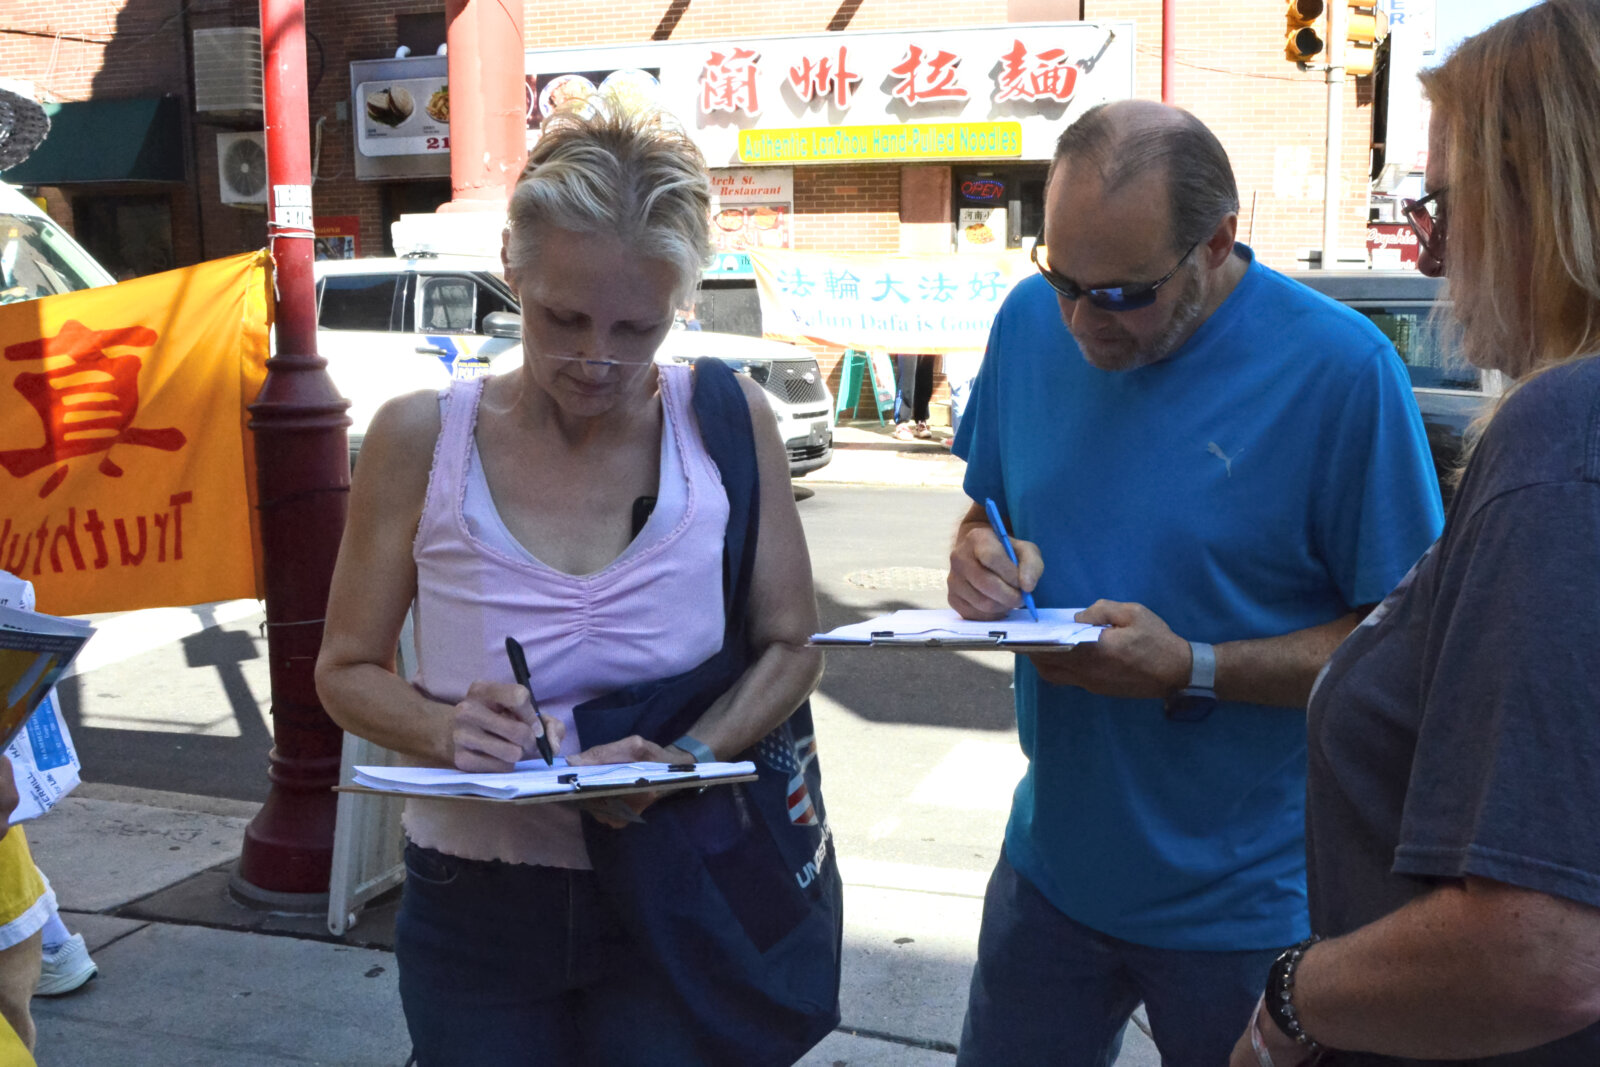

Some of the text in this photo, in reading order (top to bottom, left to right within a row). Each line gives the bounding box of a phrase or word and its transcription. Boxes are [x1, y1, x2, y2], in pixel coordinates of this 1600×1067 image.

[744, 131, 808, 159] Authentic
[872, 126, 955, 153] Hand-Pulled
[959, 125, 1017, 152] Noodles
[720, 185, 782, 197] Restaurant
[961, 181, 1005, 199] OPEN
[776, 267, 1008, 304] 法輪大法好
[916, 314, 934, 331] is
